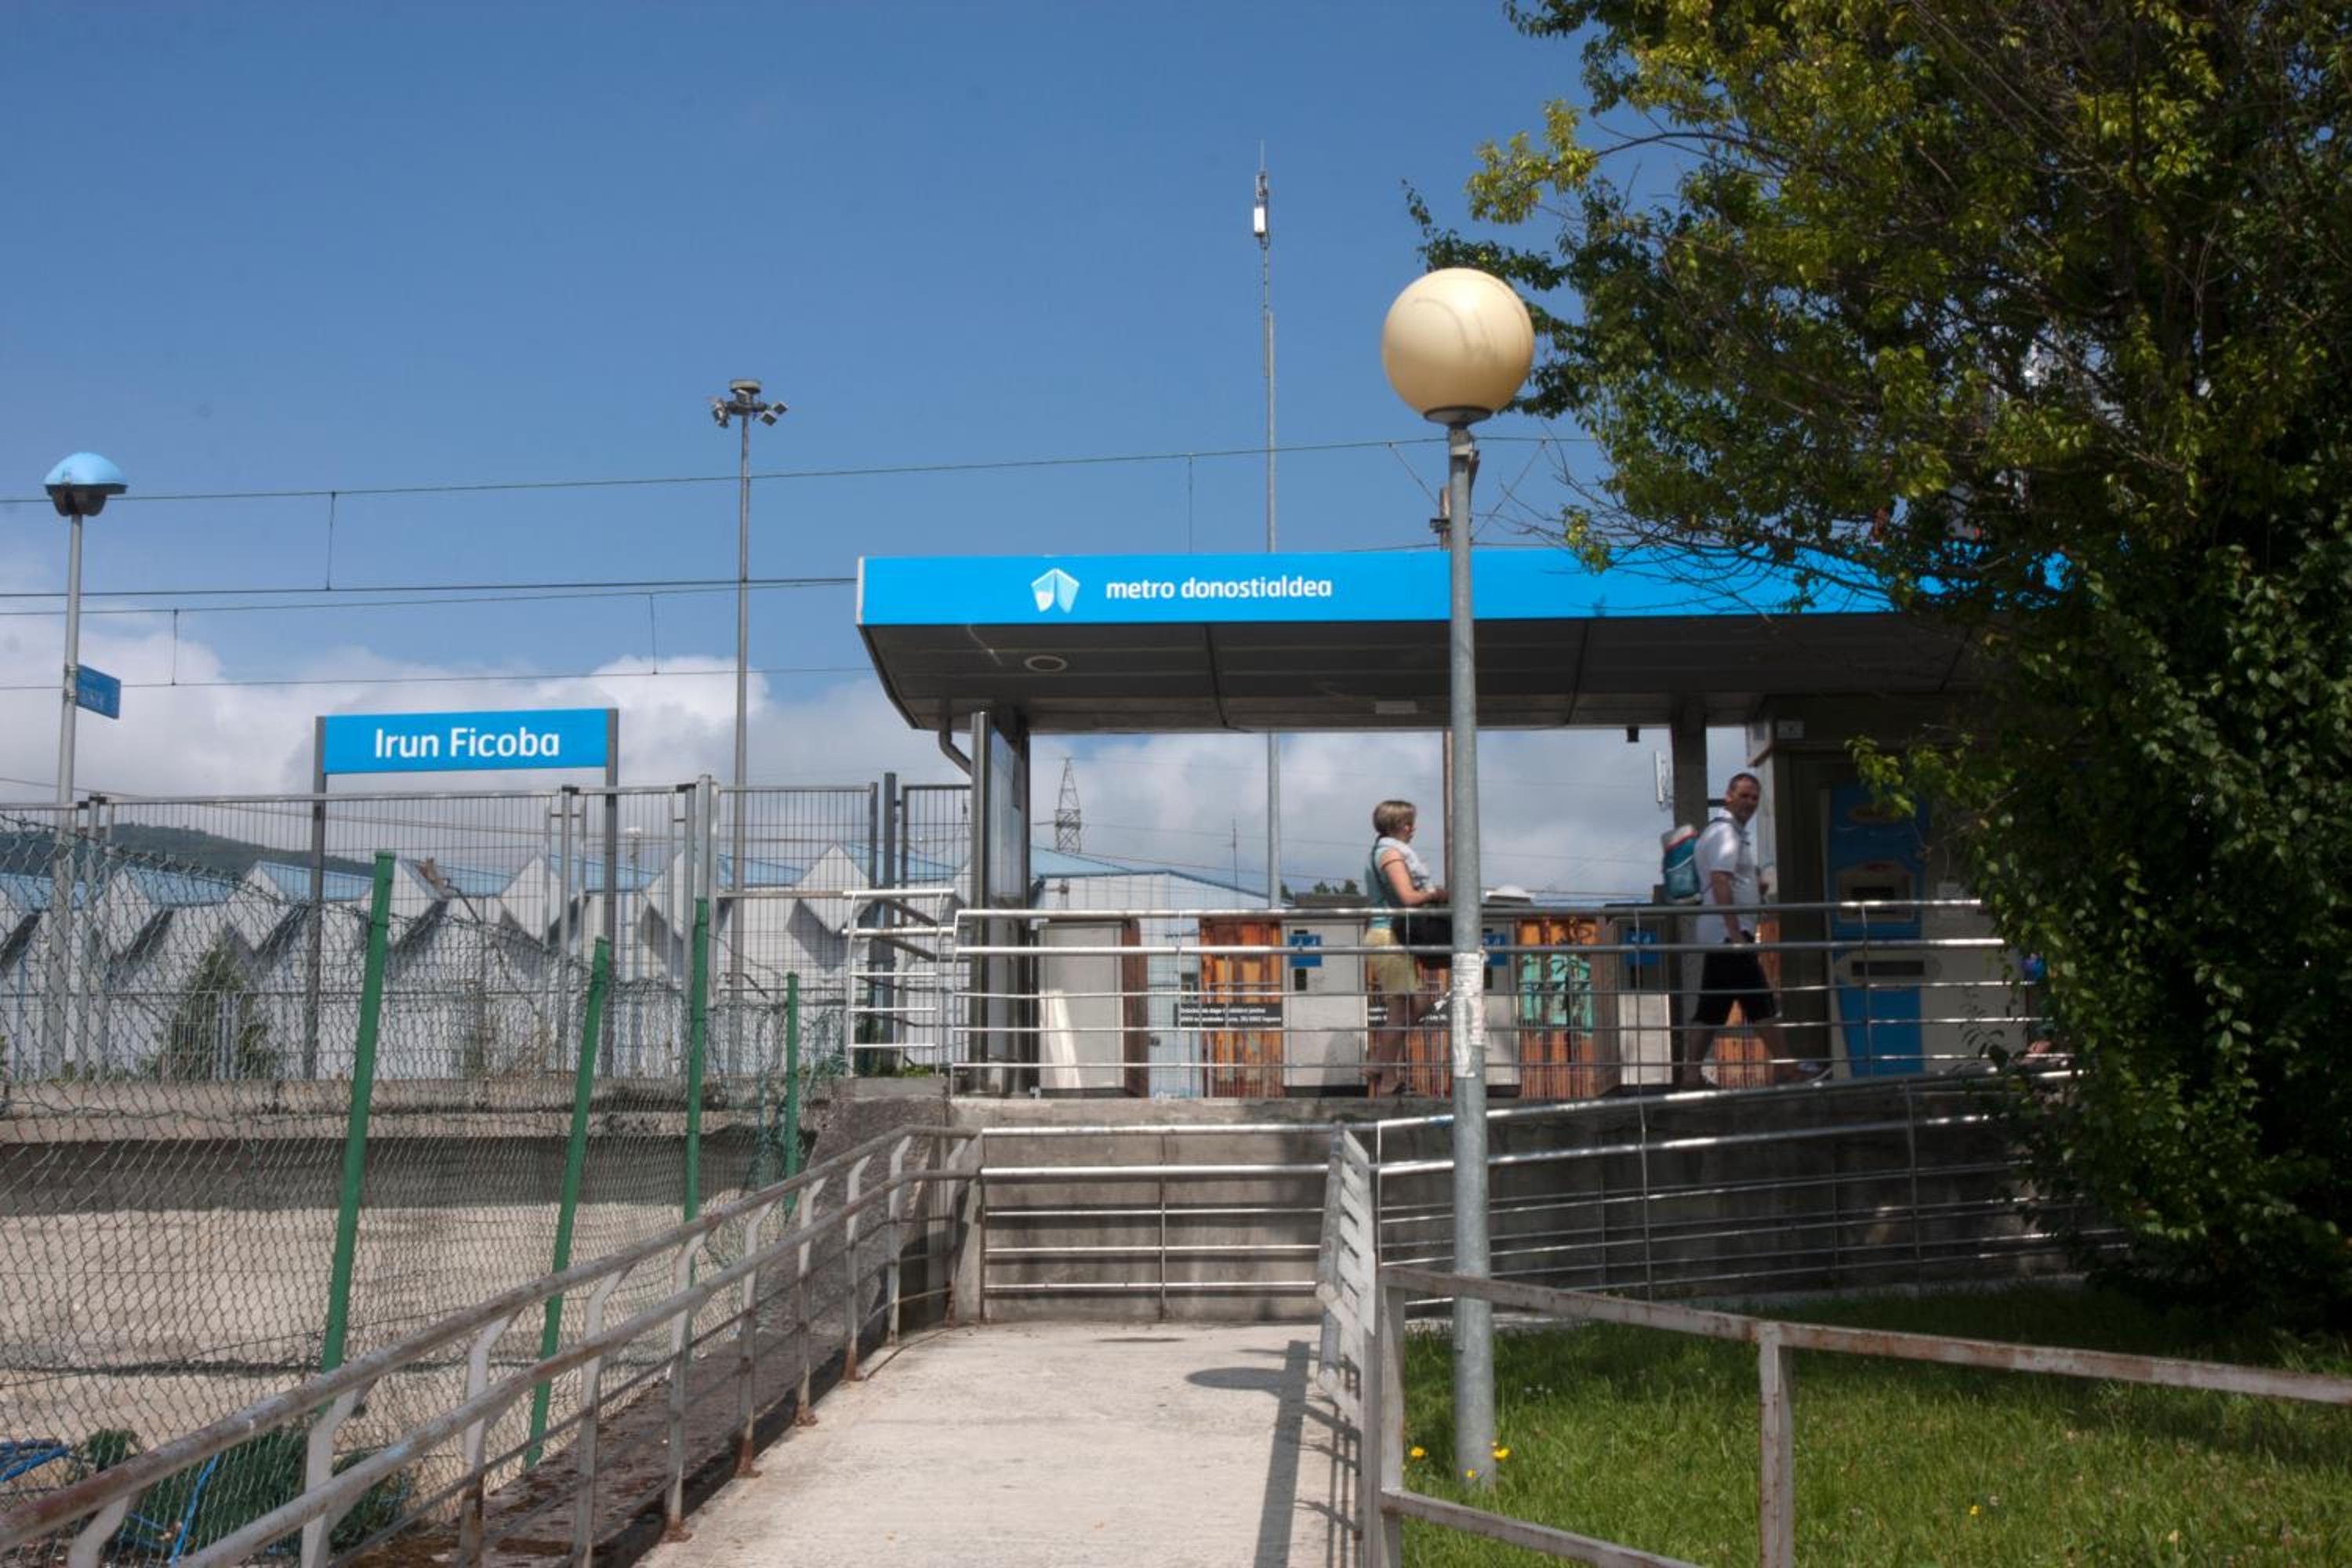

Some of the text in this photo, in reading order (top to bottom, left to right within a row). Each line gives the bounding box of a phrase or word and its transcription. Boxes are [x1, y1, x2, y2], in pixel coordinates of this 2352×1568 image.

[1106, 575, 1332, 599] metro donostialdea
[376, 727, 560, 757] Irun Ficoba
